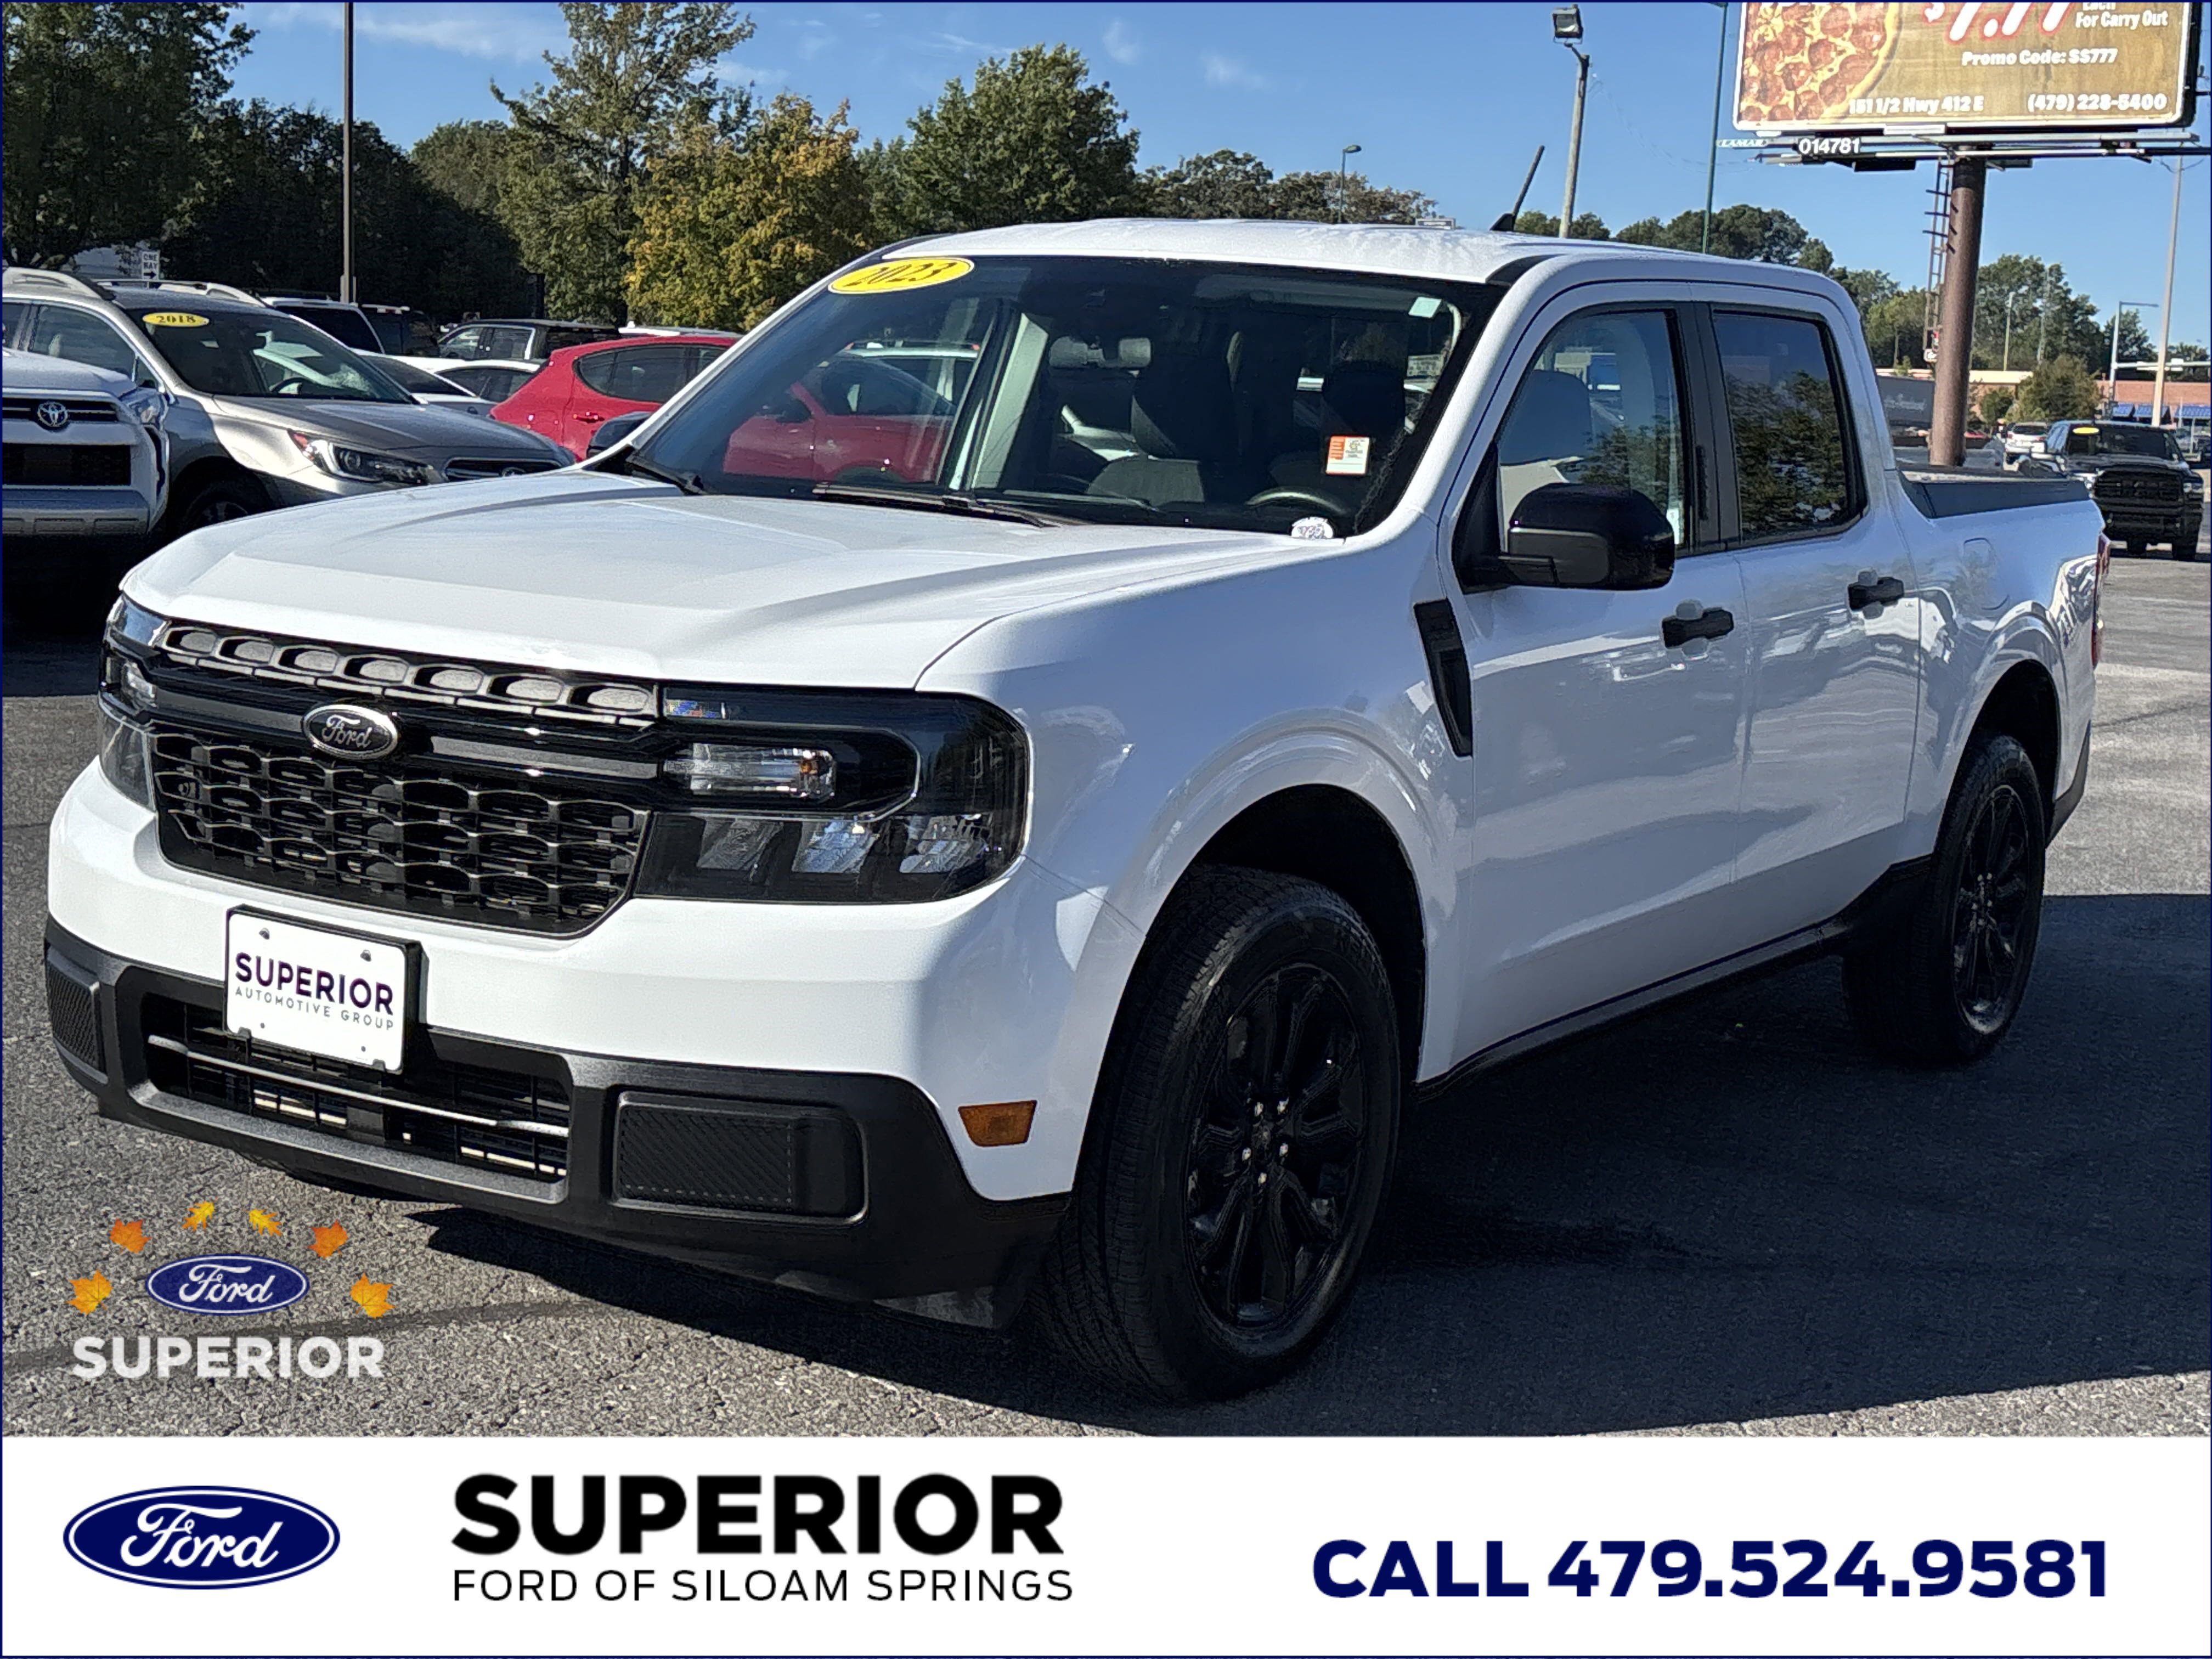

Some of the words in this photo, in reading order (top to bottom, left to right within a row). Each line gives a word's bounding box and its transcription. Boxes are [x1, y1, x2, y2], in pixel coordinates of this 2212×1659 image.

[2075, 12, 2099, 27] For
[2101, 12, 2140, 30] Carry
[2142, 10, 2168, 26] Out
[1962, 52, 2017, 65] Promo
[2019, 49, 2066, 65] Code:
[2068, 48, 2118, 64] SS777
[1875, 98, 1900, 115] 1/2
[1903, 97, 1940, 115] Hwy
[1942, 96, 1971, 111] 412
[1973, 95, 1984, 111] E
[2028, 93, 2074, 112] (479)
[2076, 93, 2167, 110] 228-5400
[1798, 138, 1860, 154] 014781
[842, 262, 958, 287] 2023
[321, 714, 373, 748] Ford
[235, 952, 393, 1015] SUPERIOR
[235, 986, 331, 1017] AUTOMOTIVE
[340, 1009, 394, 1030] GROUP
